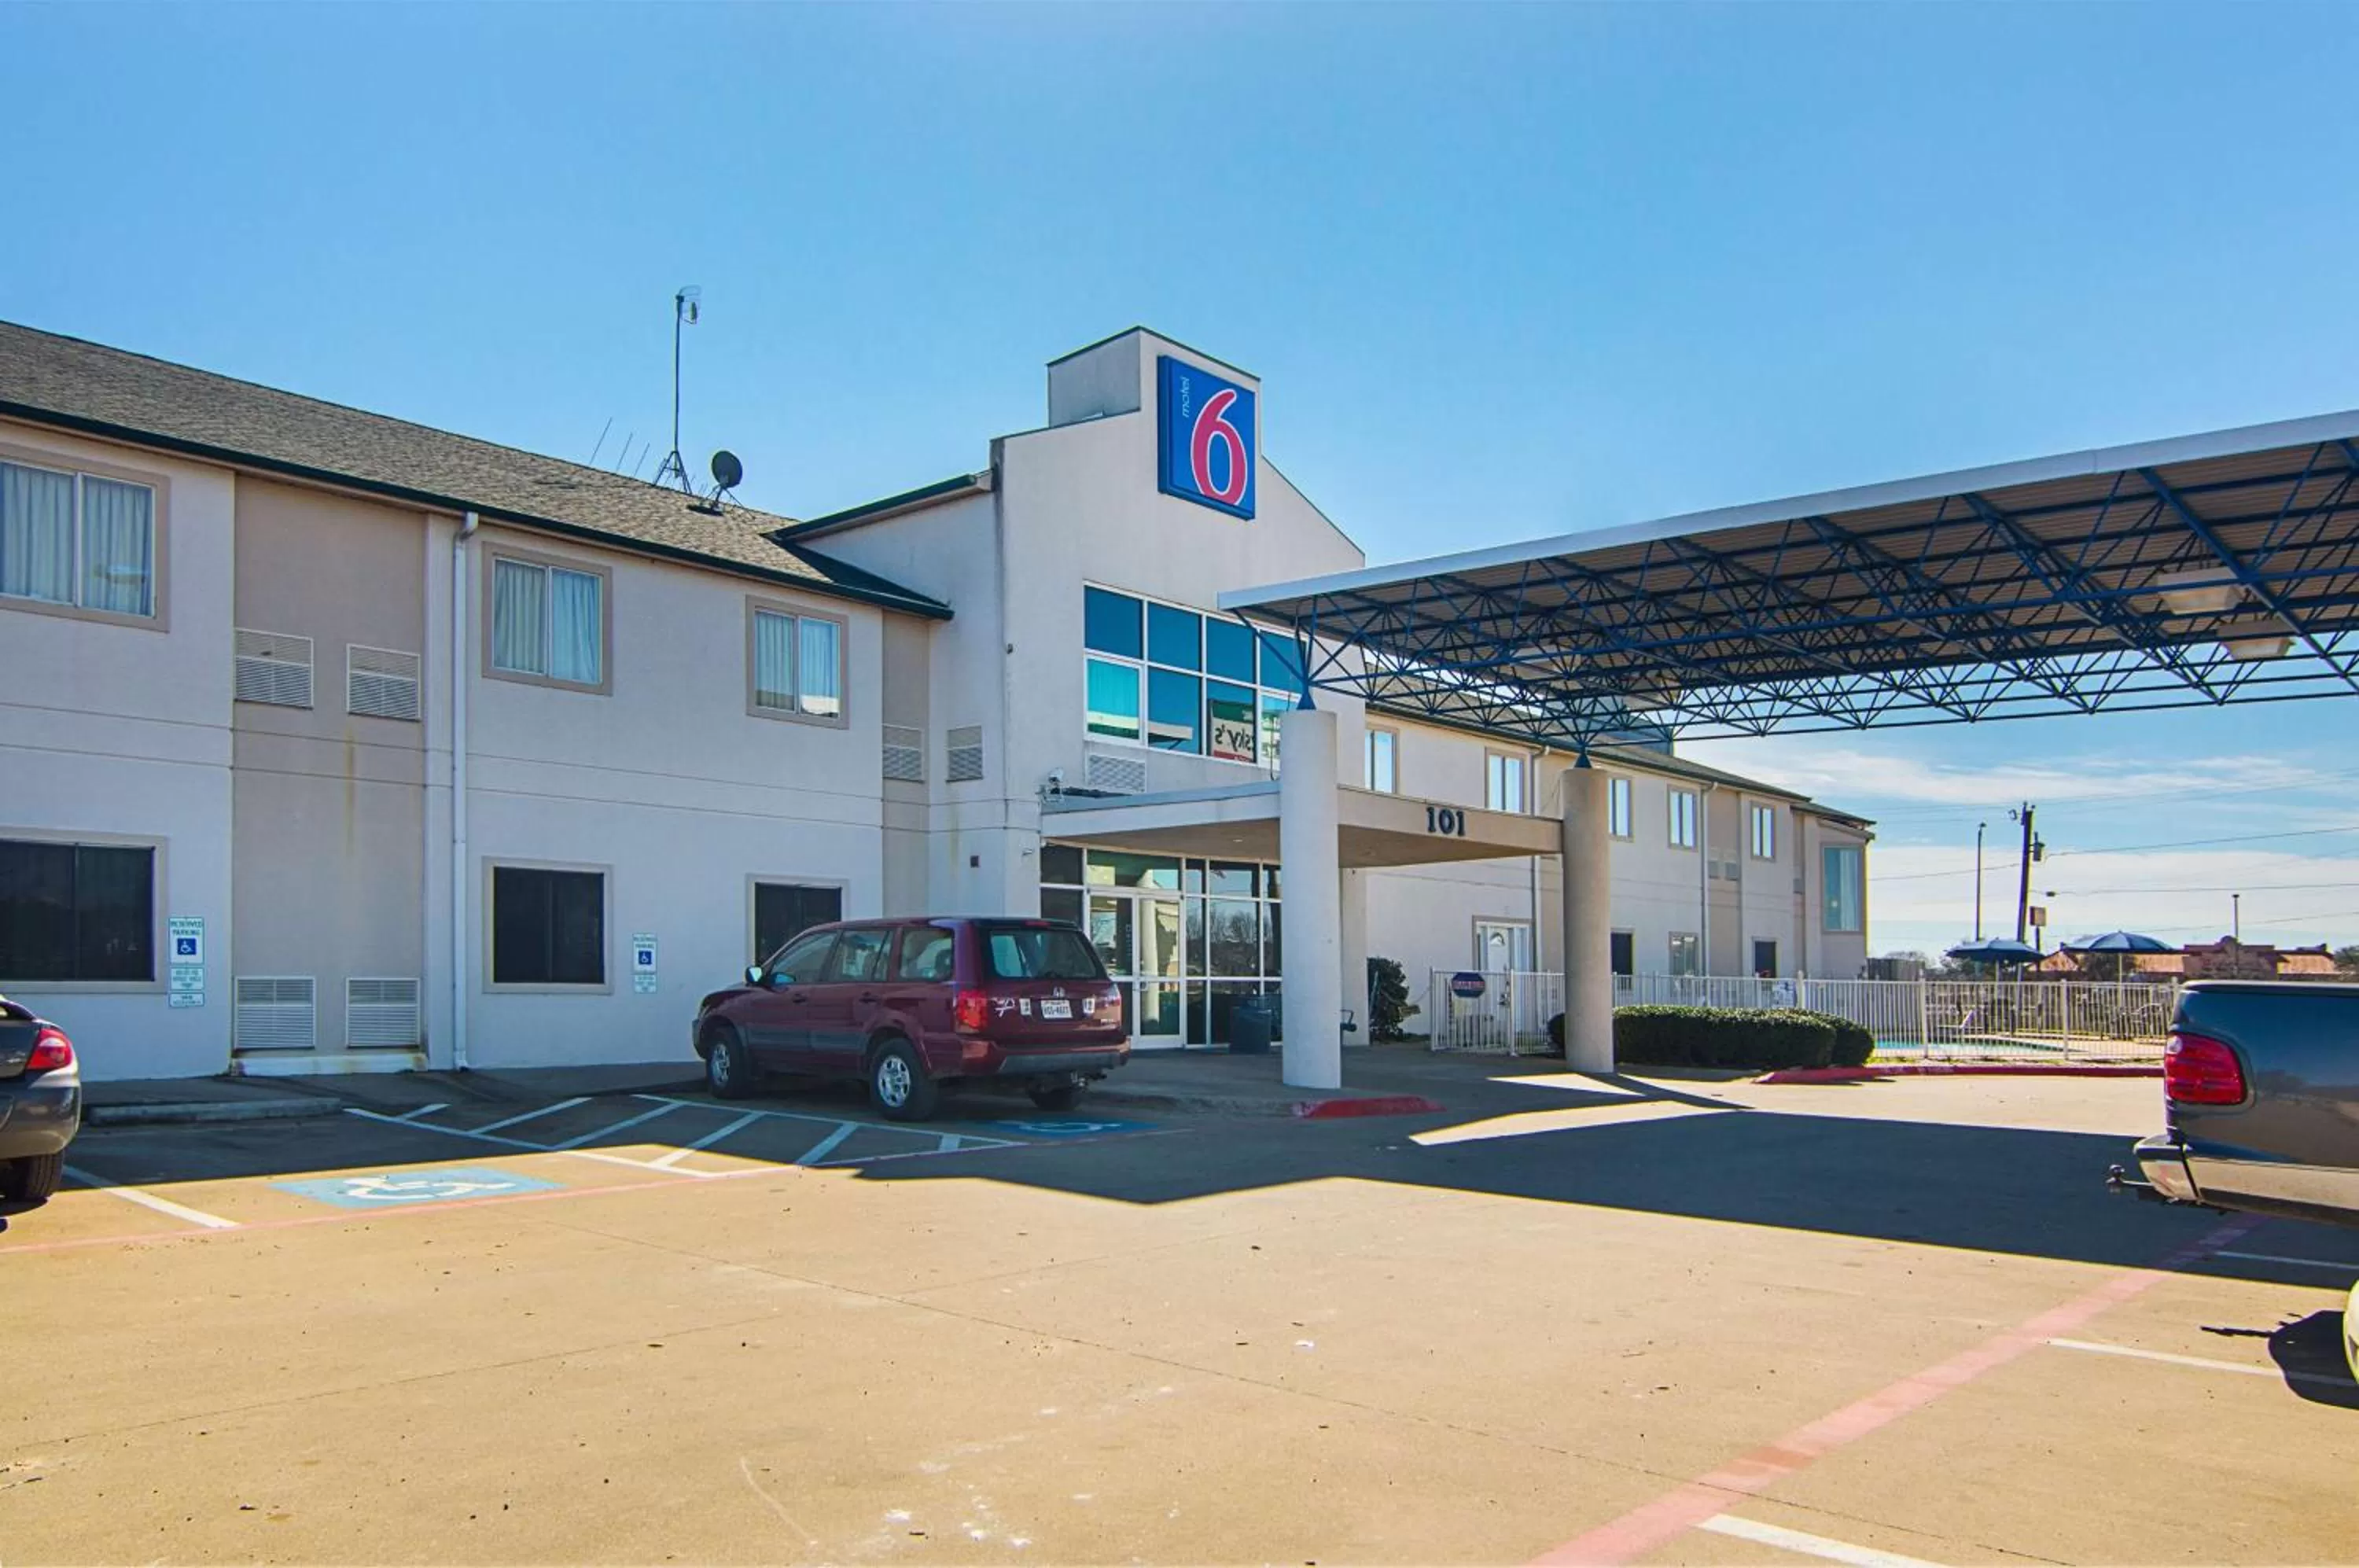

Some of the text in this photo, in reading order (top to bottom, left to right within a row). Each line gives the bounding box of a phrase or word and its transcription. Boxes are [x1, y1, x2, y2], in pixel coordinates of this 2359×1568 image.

[1181, 376, 1190, 418] motel
[1191, 388, 1247, 506] 6
[1426, 806, 1466, 837] 101
